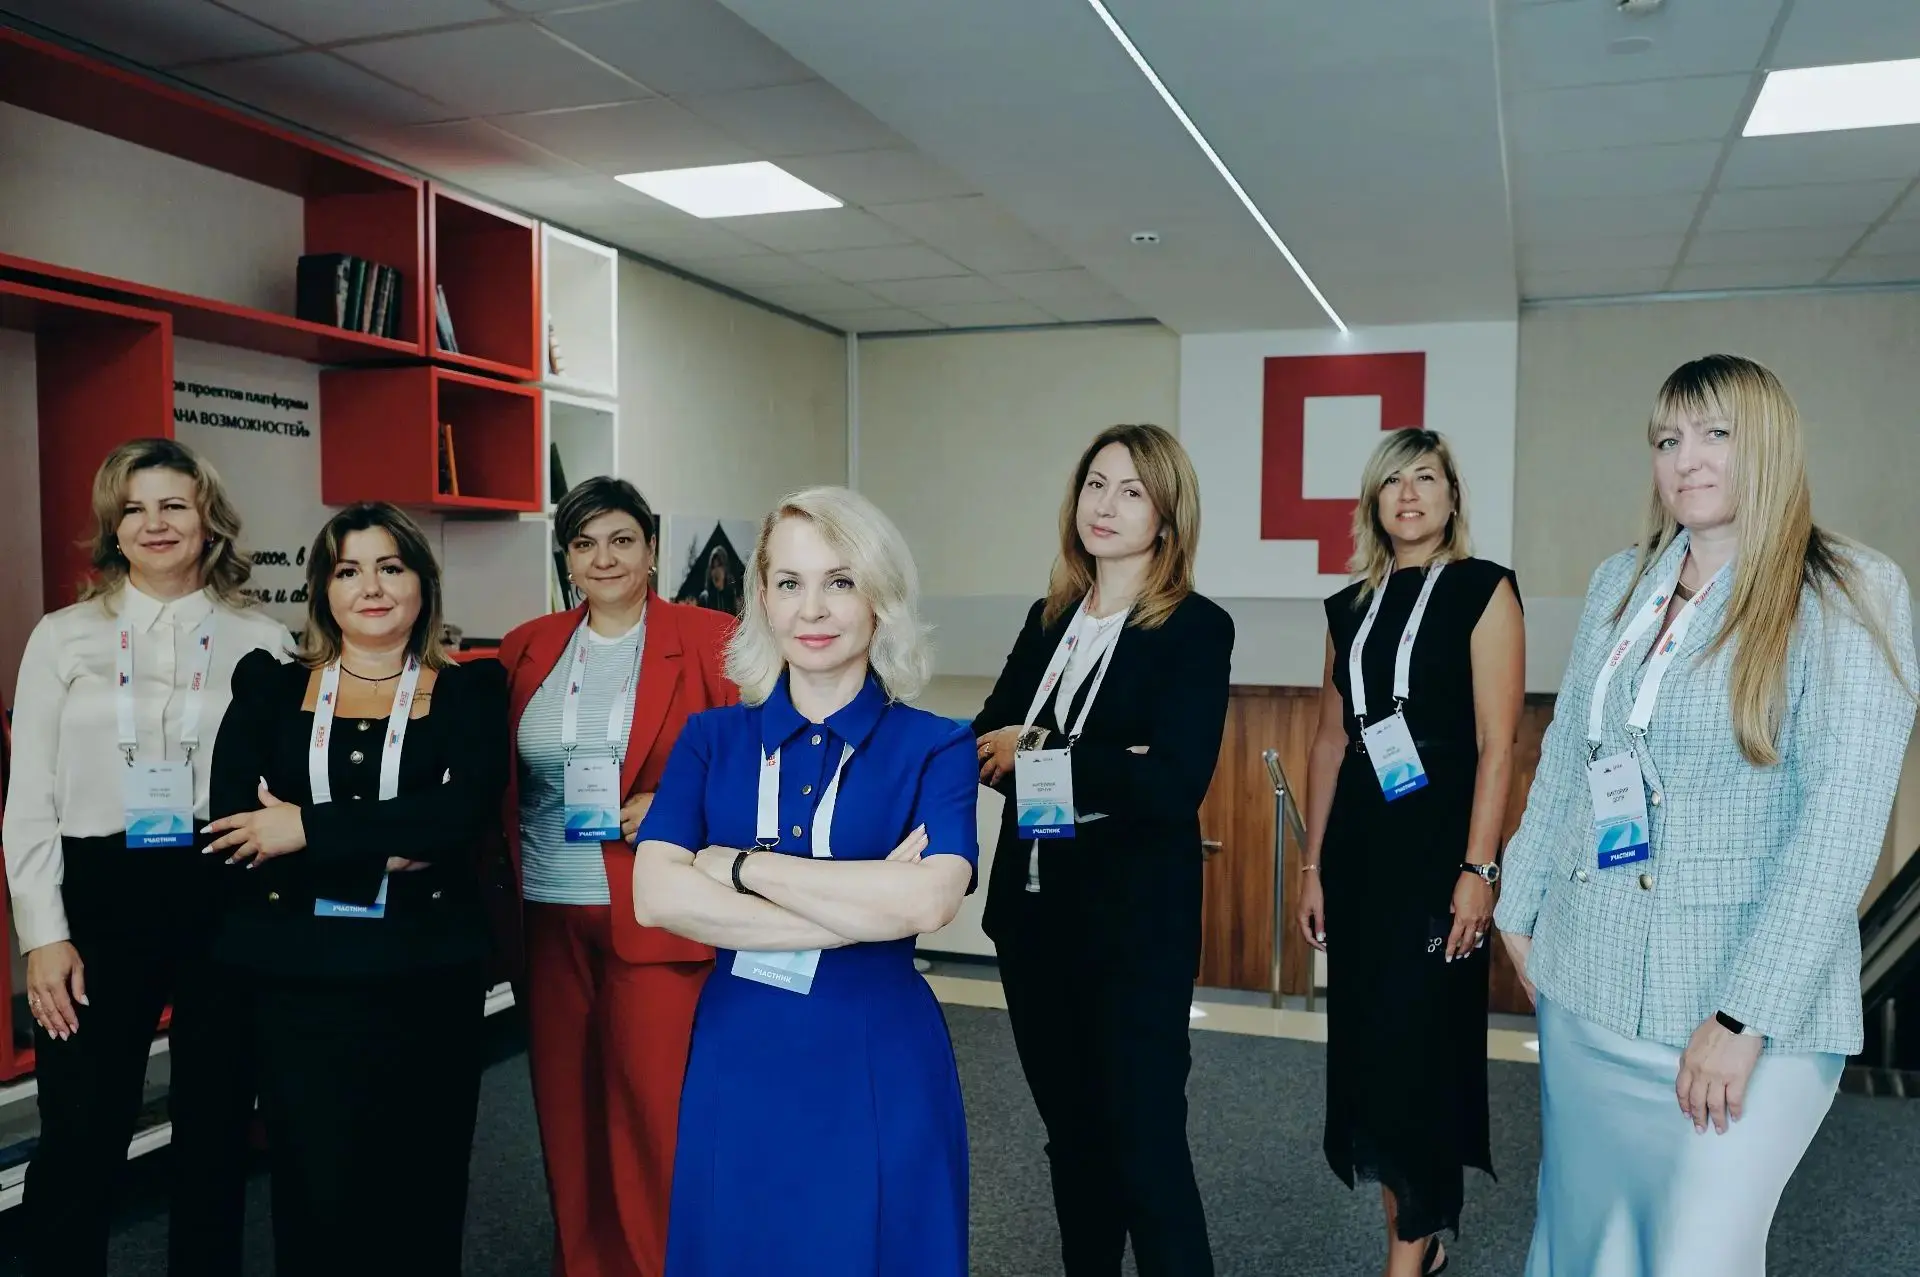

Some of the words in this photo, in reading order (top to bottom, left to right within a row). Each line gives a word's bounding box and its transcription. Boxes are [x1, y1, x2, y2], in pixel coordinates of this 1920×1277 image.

[187, 382, 243, 400] проектов
[245, 392, 309, 411] платформы
[200, 411, 311, 438] ВОЗМОЖНОСТЕЙ»
[332, 904, 368, 913] УЧАСТНИК
[752, 967, 793, 984] УЧАСТНИК
